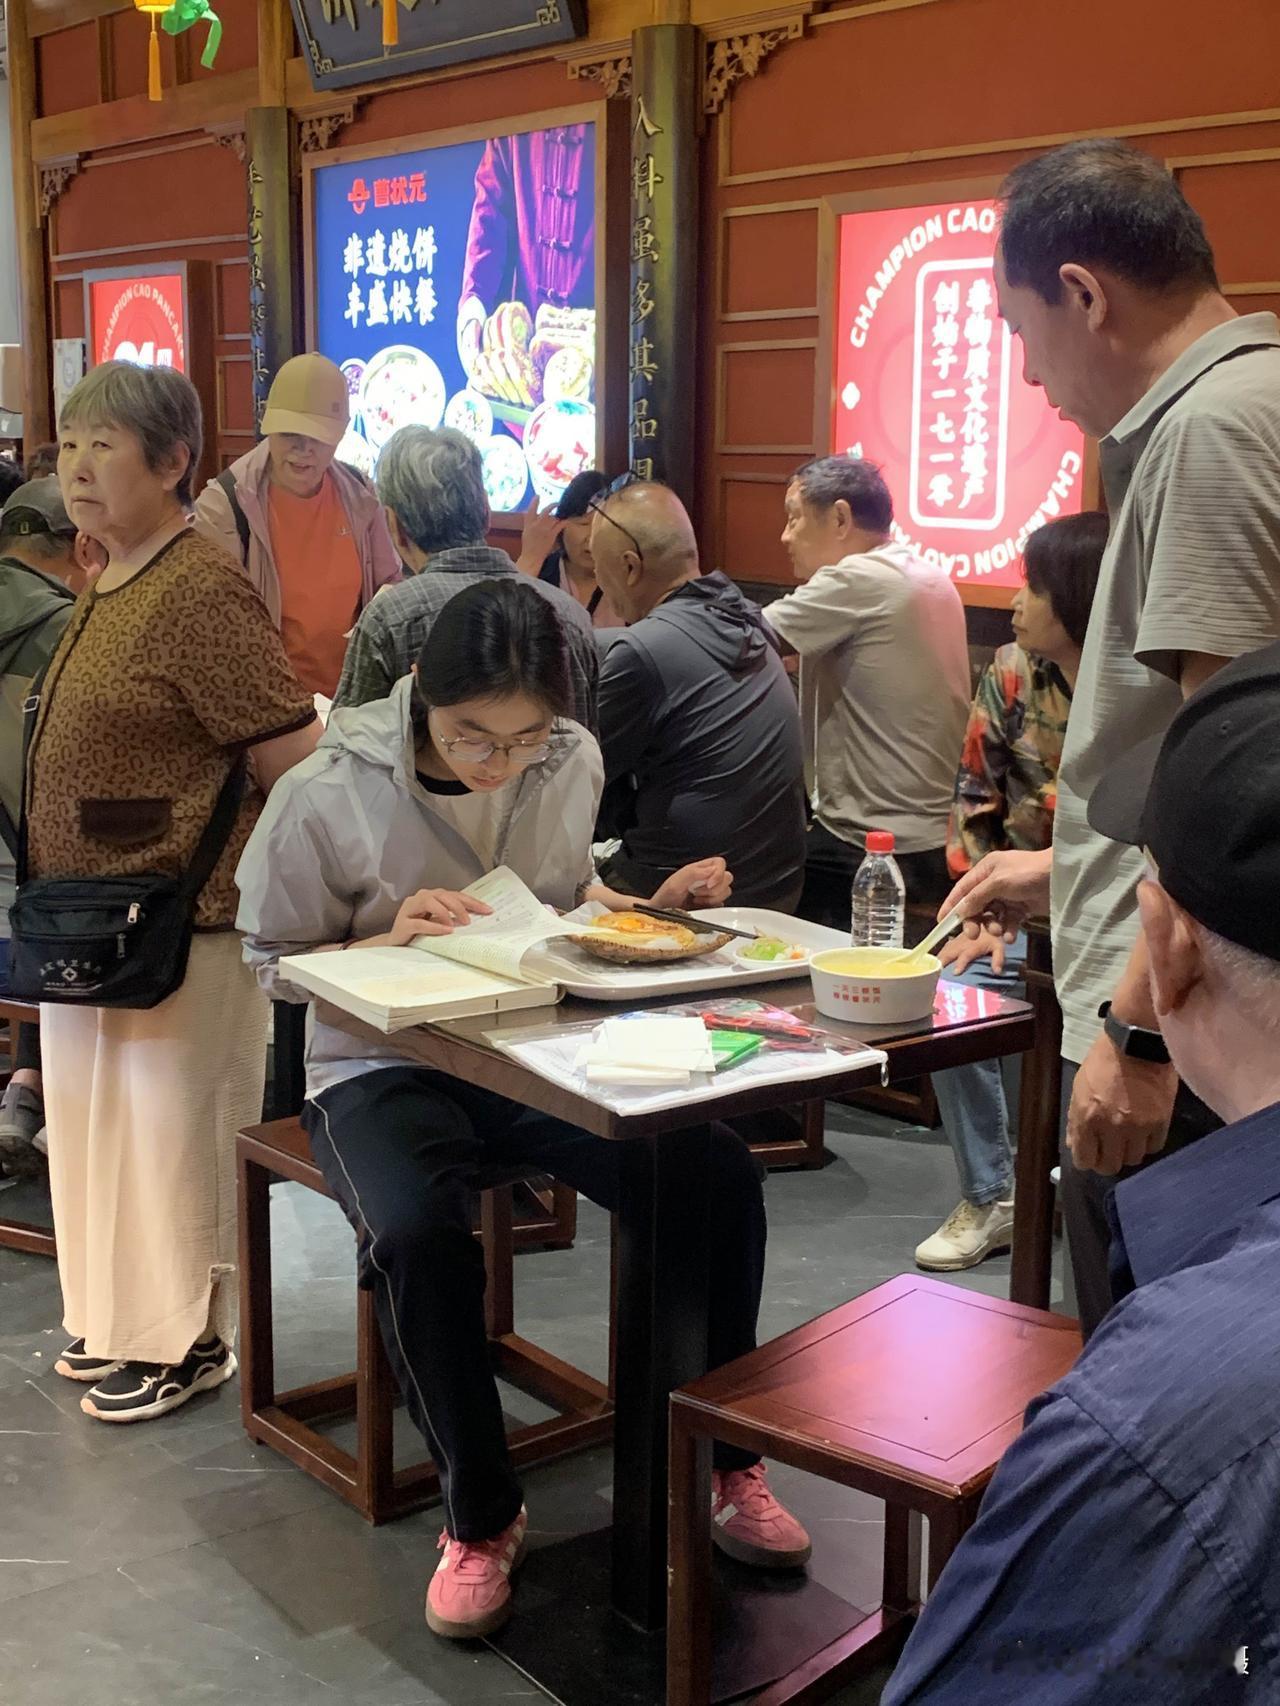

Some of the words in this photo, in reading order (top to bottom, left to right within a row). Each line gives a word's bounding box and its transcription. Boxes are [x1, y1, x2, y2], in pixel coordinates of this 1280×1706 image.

[373, 173, 427, 207] 曹状元
[343, 225, 438, 279] 非遗烧饼
[850, 214, 943, 347] CHAMPION
[947, 208, 995, 233] CAO
[133, 283, 150, 298] CAO
[344, 276, 438, 328] 丰盛快餐
[958, 278, 993, 509] 非物质文化遗产
